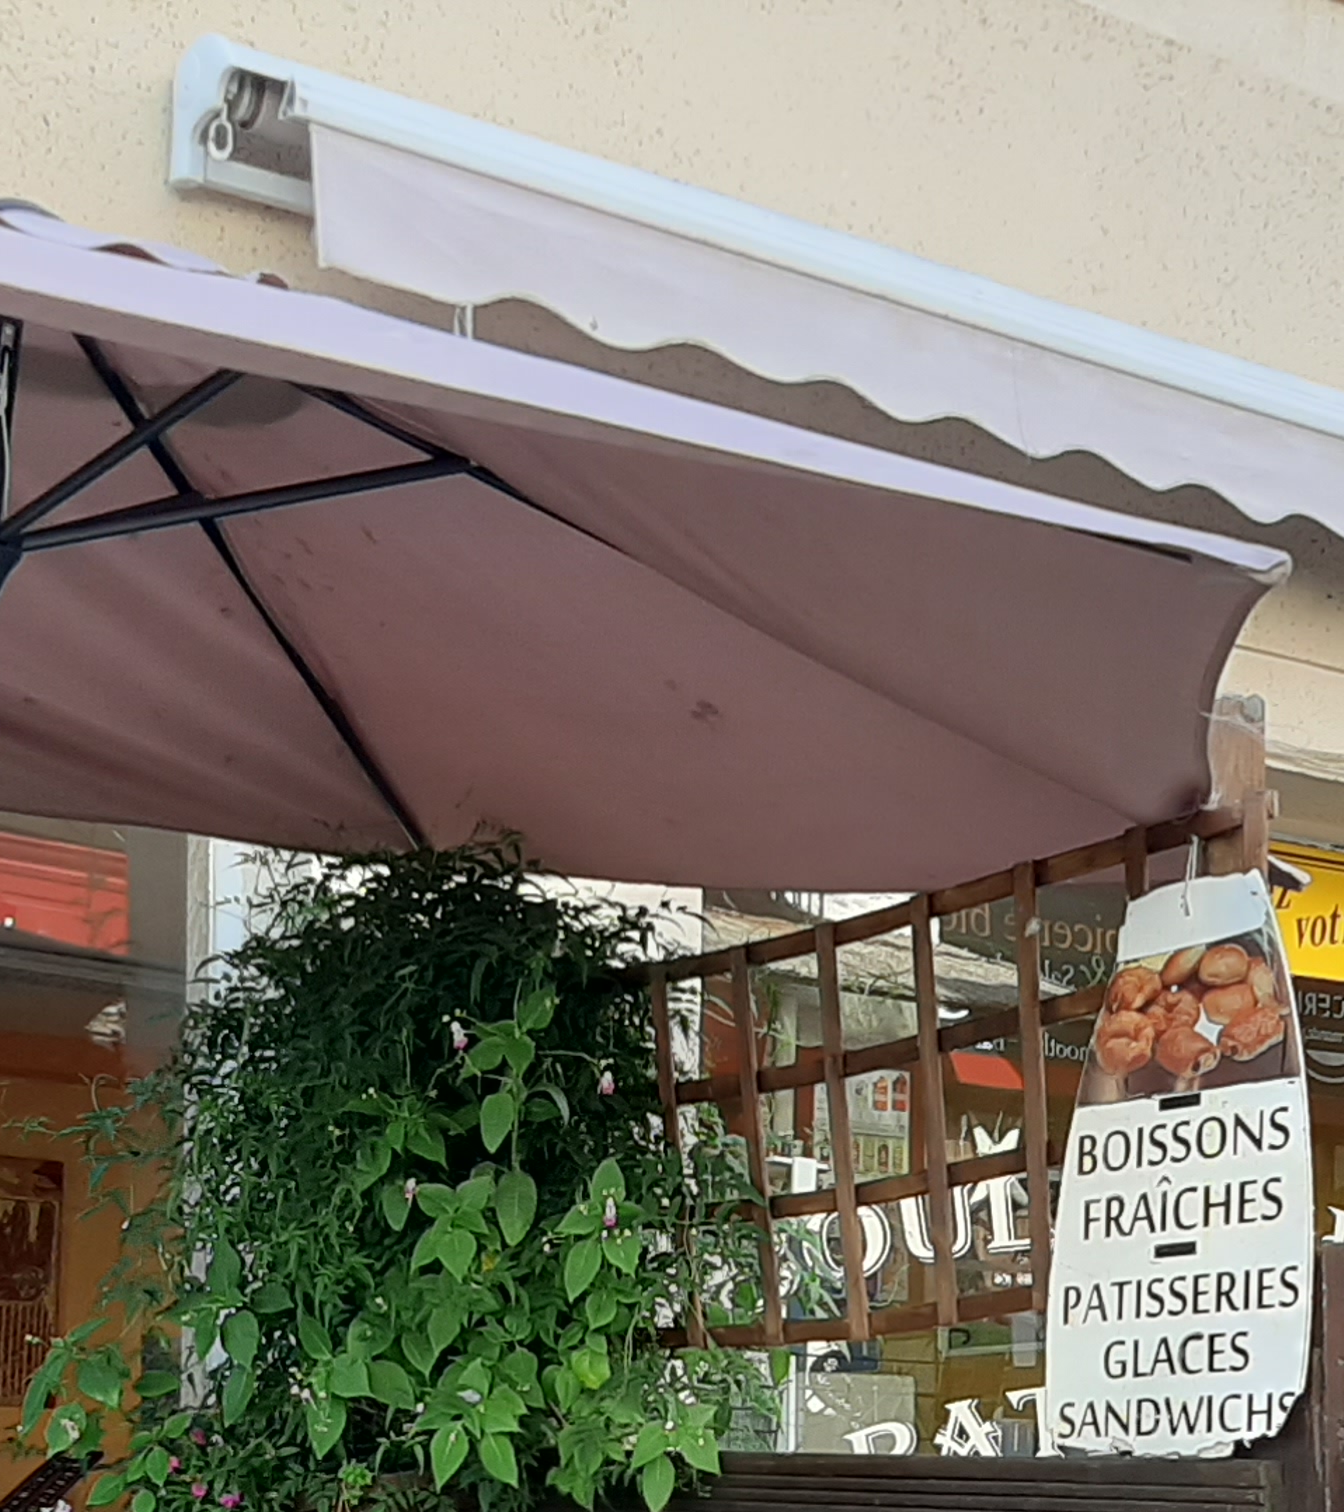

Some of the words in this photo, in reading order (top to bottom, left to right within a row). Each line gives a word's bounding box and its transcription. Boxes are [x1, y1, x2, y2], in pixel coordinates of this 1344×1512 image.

[1076, 1104, 1292, 1178] BOISSONS
[1081, 1177, 1285, 1243] FRAÎCHES
[1061, 1264, 1300, 1328] PATISSERIES
[1101, 1330, 1253, 1380] GLACES
